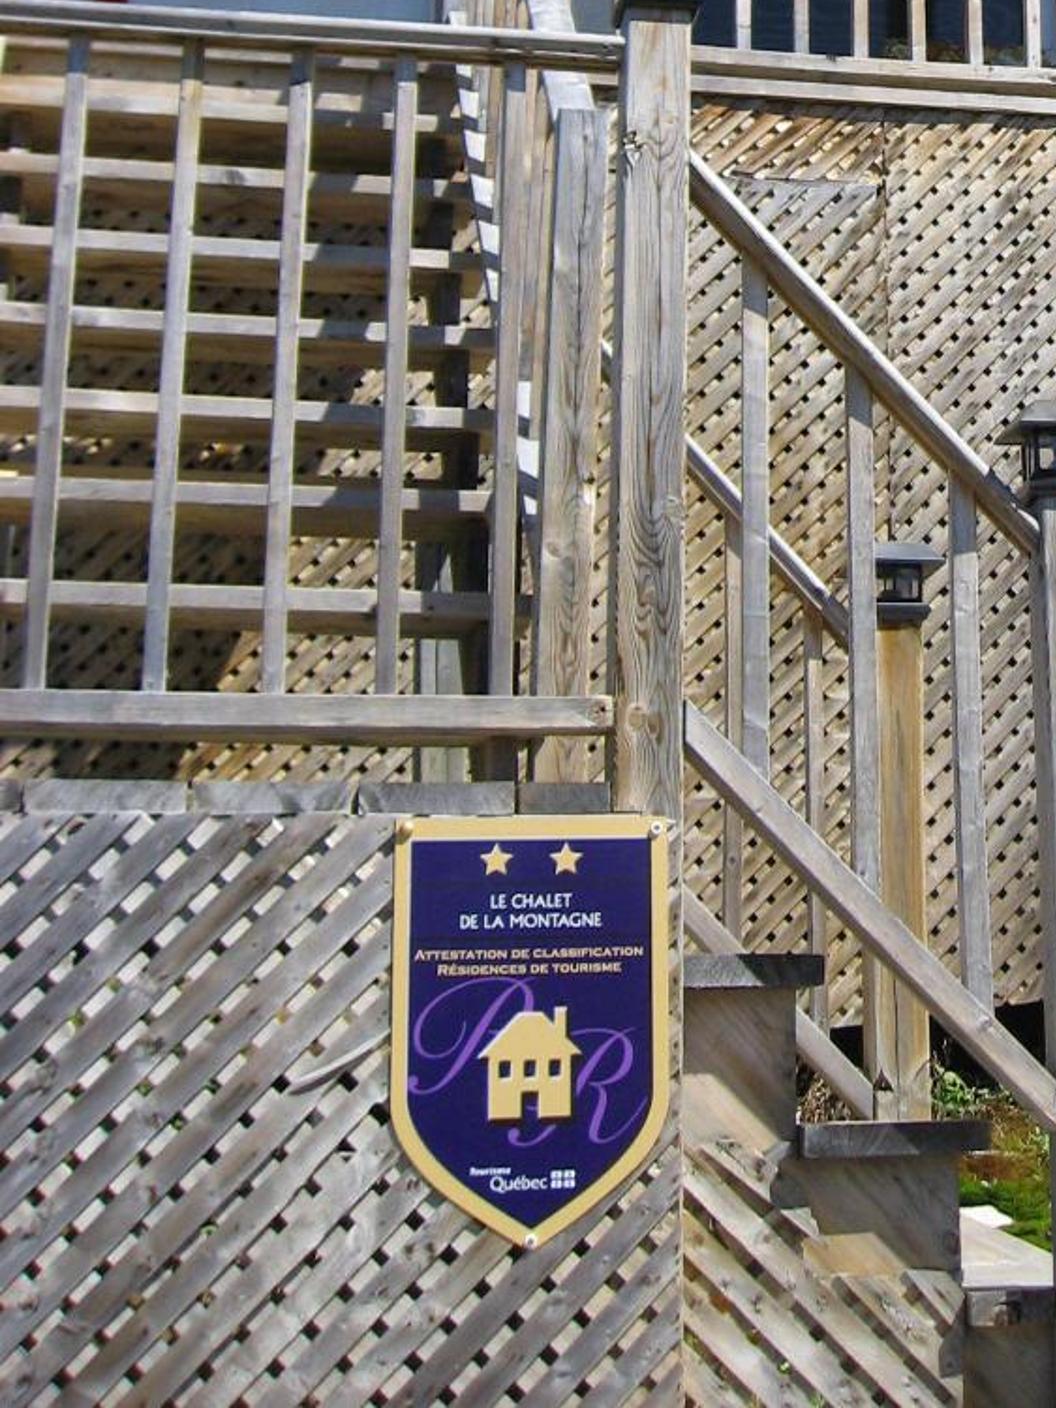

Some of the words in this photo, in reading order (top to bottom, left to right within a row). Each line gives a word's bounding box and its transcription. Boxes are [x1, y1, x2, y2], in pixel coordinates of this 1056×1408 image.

[490, 894, 507, 909] LE
[511, 893, 573, 908] CHALET
[459, 914, 479, 930] DE
[484, 914, 504, 929] LA
[509, 912, 602, 928] MONTAGNE
[414, 949, 507, 961] ATTESTATION
[511, 949, 529, 959] DE
[533, 946, 644, 959] CLASSIFICATION
[437, 962, 526, 976] RÉSIDENCES
[530, 963, 549, 974] DE
[552, 962, 622, 973] TOURISME
[489, 1174, 548, 1193] Québec
